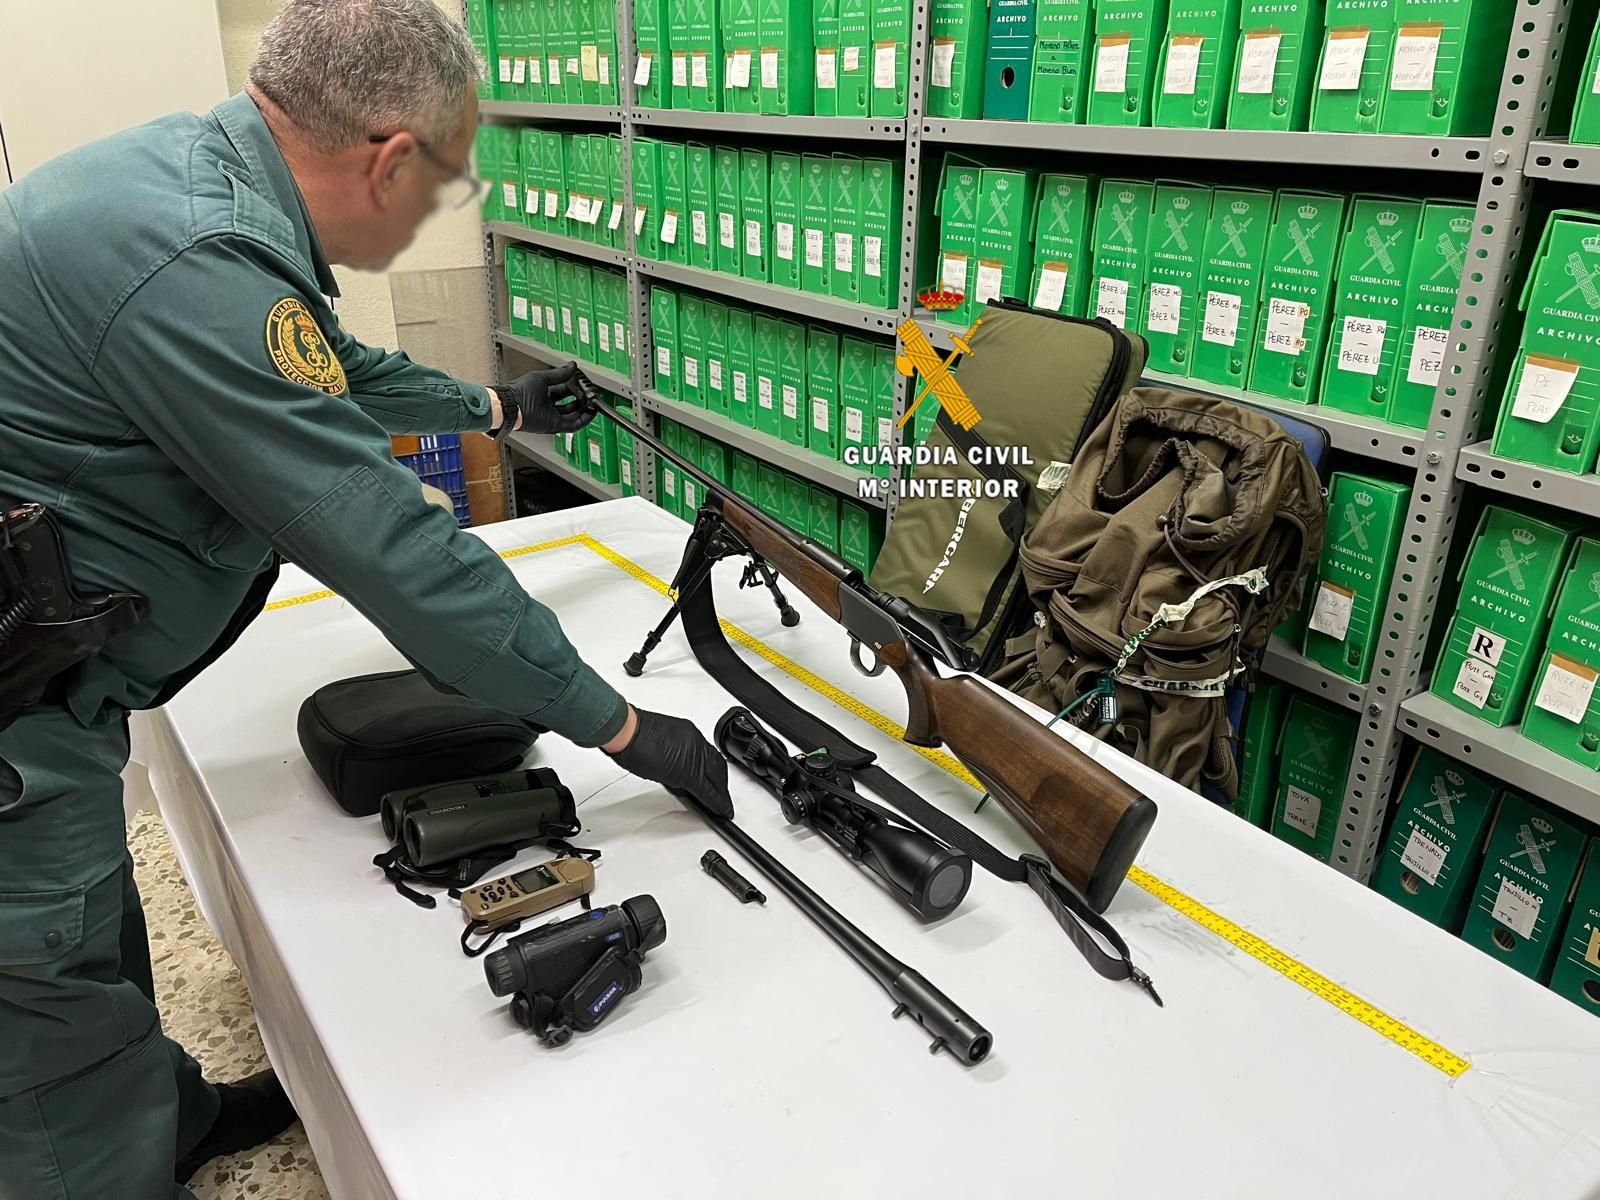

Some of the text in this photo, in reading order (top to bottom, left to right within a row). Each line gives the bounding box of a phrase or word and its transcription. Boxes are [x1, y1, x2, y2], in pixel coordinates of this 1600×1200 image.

[1251, 5, 1298, 13] ARCHIVO
[1337, 1, 1388, 9] ARCHIVO
[936, 16, 964, 25] ARCHIVO
[996, 15, 1027, 23] ARCHIVO
[1103, 11, 1143, 20] ARCHIVO
[1176, 10, 1217, 18] ARCHIVO
[980, 240, 1012, 251] ARCHIVO
[1041, 248, 1073, 259] ARCHIVO
[1100, 258, 1137, 270] ARCHIVO
[1209, 258, 1235, 267] GUARDIA
[1152, 266, 1192, 278] ARCHIVO
[1274, 265, 1320, 278] GUARDIA CIVIL
[1207, 274, 1250, 286] ARCHIVO
[1350, 275, 1402, 287] GUARDIA CIVIL
[1271, 282, 1317, 295] ARCHIVO
[1419, 284, 1454, 294] GUARDIA
[1346, 292, 1399, 306] ARCHIVO
[271, 300, 302, 323] GUARDIA
[1272, 300, 1296, 316] PÉREZ
[1416, 303, 1454, 314] ARCHI
[1542, 307, 1600, 323] GUARDIA CIV
[1347, 319, 1372, 334] PÉREZ
[1268, 330, 1291, 346] PÉREZ
[1418, 328, 1448, 343] PÉREZ
[1342, 349, 1370, 364] PÉREZ
[1420, 358, 1441, 371] PEZ
[1330, 544, 1374, 564] GUARDIA CIVIL
[1328, 559, 1371, 580] ARCHIVO
[1476, 579, 1531, 607] GUARDIA CIVIL
[1471, 595, 1526, 623] ARCHIVO
[1472, 632, 1494, 659] R
[1288, 771, 1333, 794] ARCHIVO
[1413, 807, 1457, 841] GUARDIA CIVIL
[1407, 820, 1451, 853] ARCHIVO
[1499, 858, 1550, 891] GUARDIA CIVIL
[599, 986, 617, 1007] PULSAR
